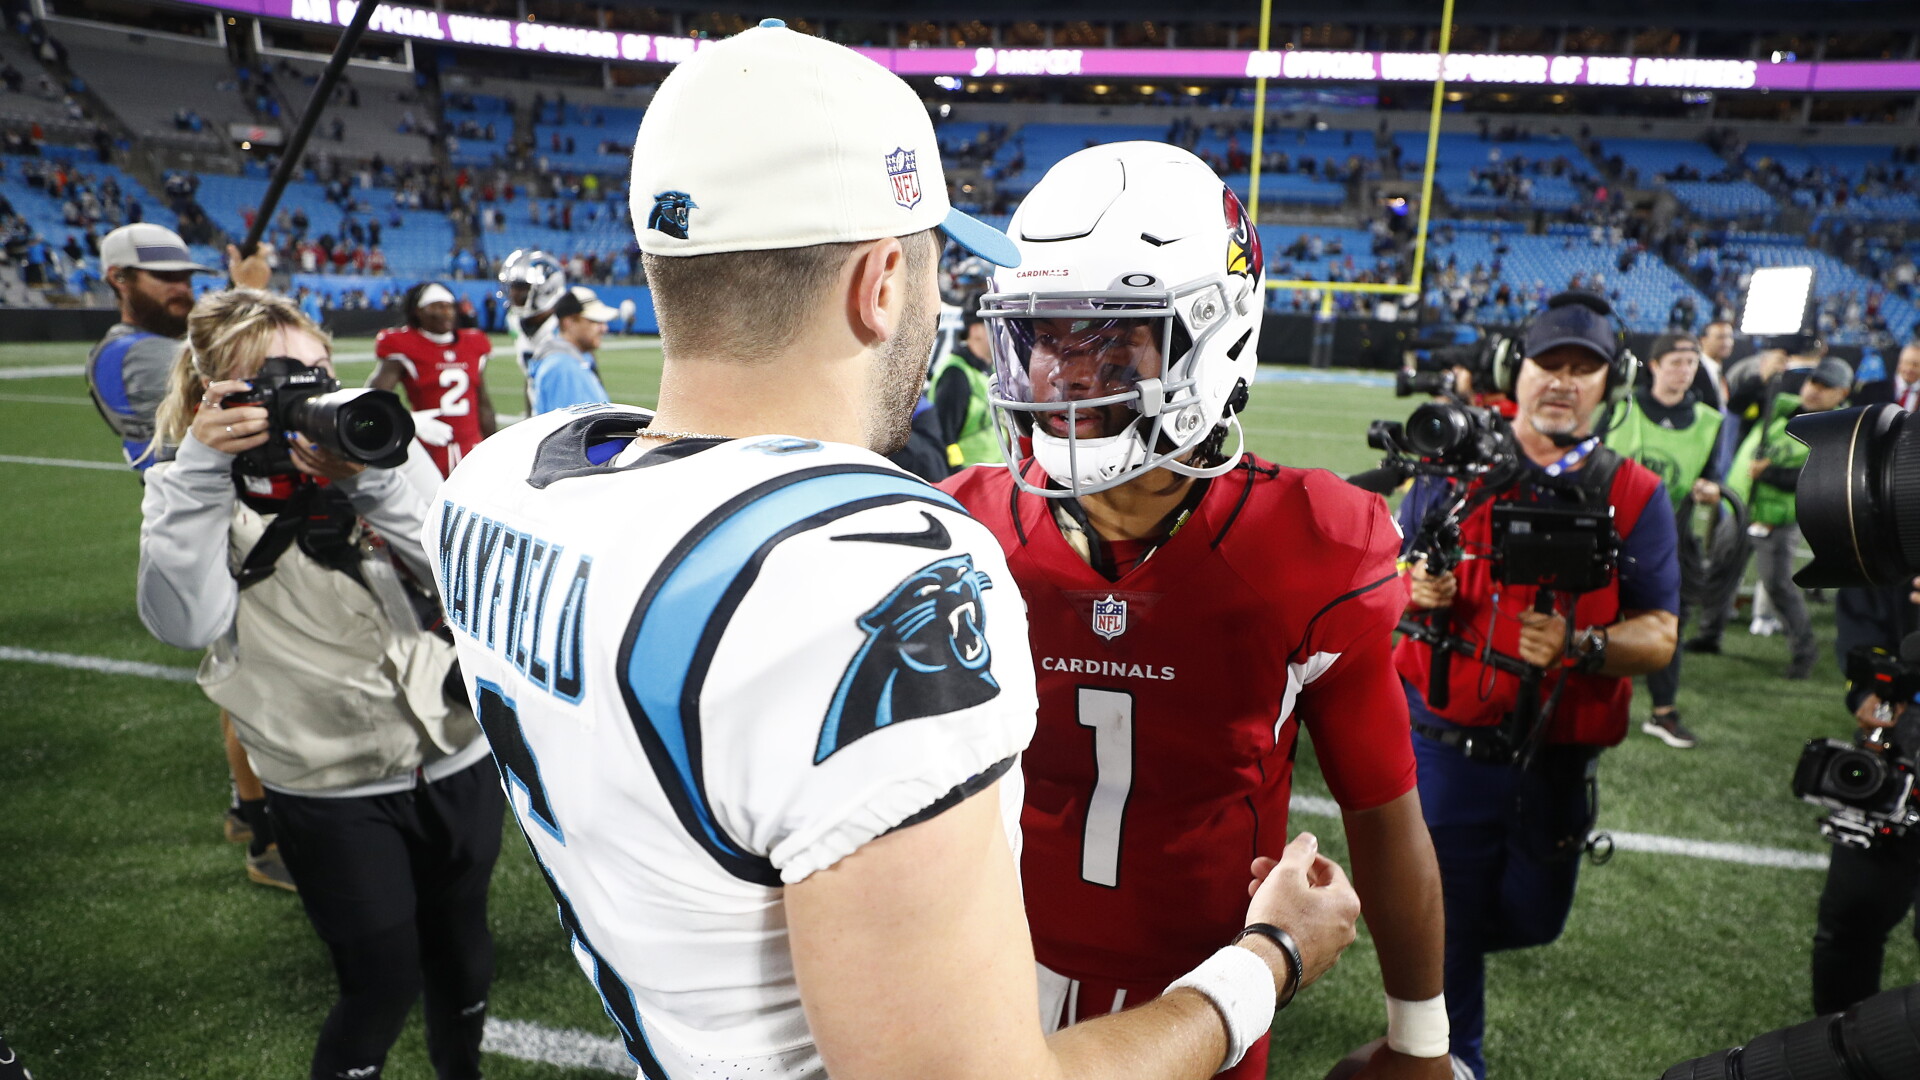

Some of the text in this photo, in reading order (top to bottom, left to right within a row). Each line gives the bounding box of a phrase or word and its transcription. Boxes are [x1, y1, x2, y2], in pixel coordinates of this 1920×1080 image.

[337, 1, 444, 40] OFICIAL
[516, 22, 619, 59] SPONSOR
[621, 34, 650, 61] OF
[1283, 51, 1377, 80] OFFICIAL
[1443, 54, 1548, 83] SPONSOR
[1550, 56, 1584, 84] OF
[1587, 57, 1632, 86] THE
[1634, 58, 1757, 88] PANTHERS
[893, 174, 919, 202] NFL
[289, 375, 316, 385] Nikon
[438, 371, 470, 416] 2
[440, 500, 594, 706] MAYFIELD
[1098, 615, 1121, 631] NFL
[1041, 657, 1176, 681] CARDINALS
[1076, 685, 1136, 889] 1
